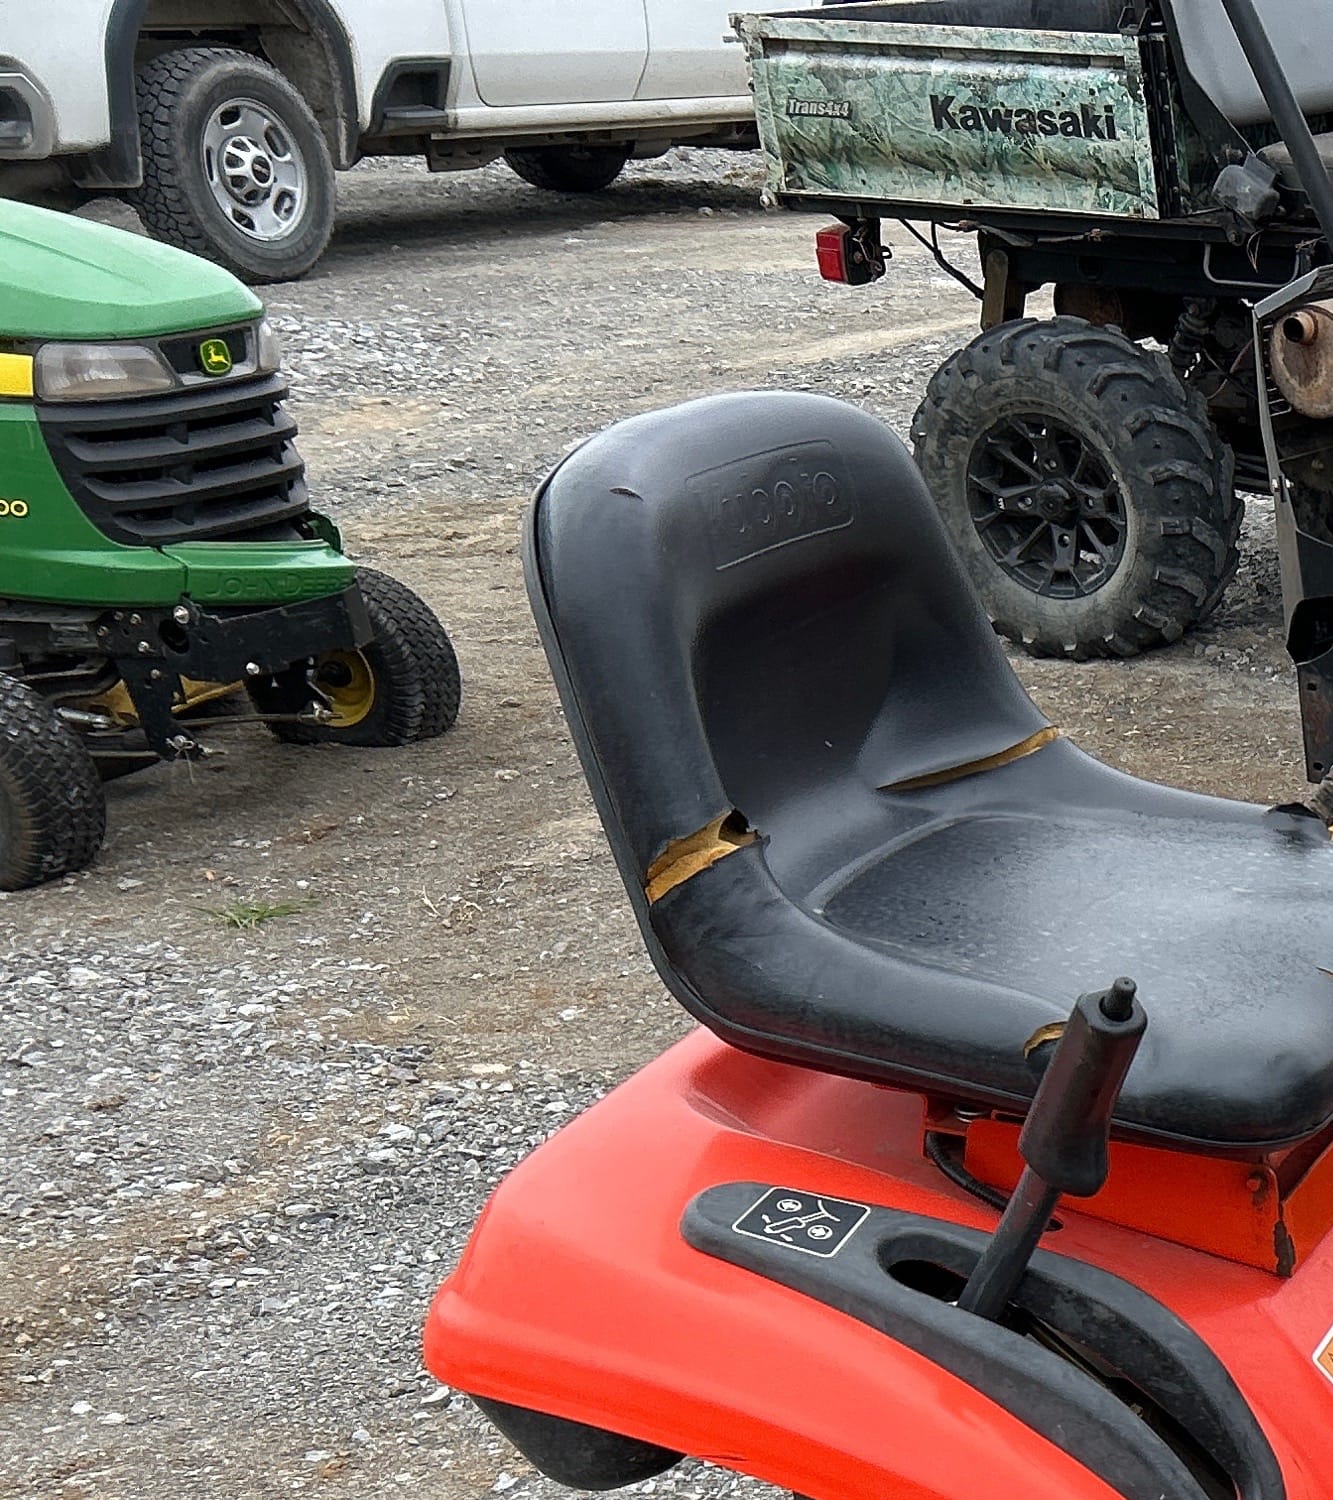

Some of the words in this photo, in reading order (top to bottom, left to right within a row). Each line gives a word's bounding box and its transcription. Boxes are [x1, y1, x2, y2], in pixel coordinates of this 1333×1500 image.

[787, 98, 850, 117] Trans4x4
[929, 94, 1119, 141] Kawasaki
[204, 572, 278, 598] JOHN
